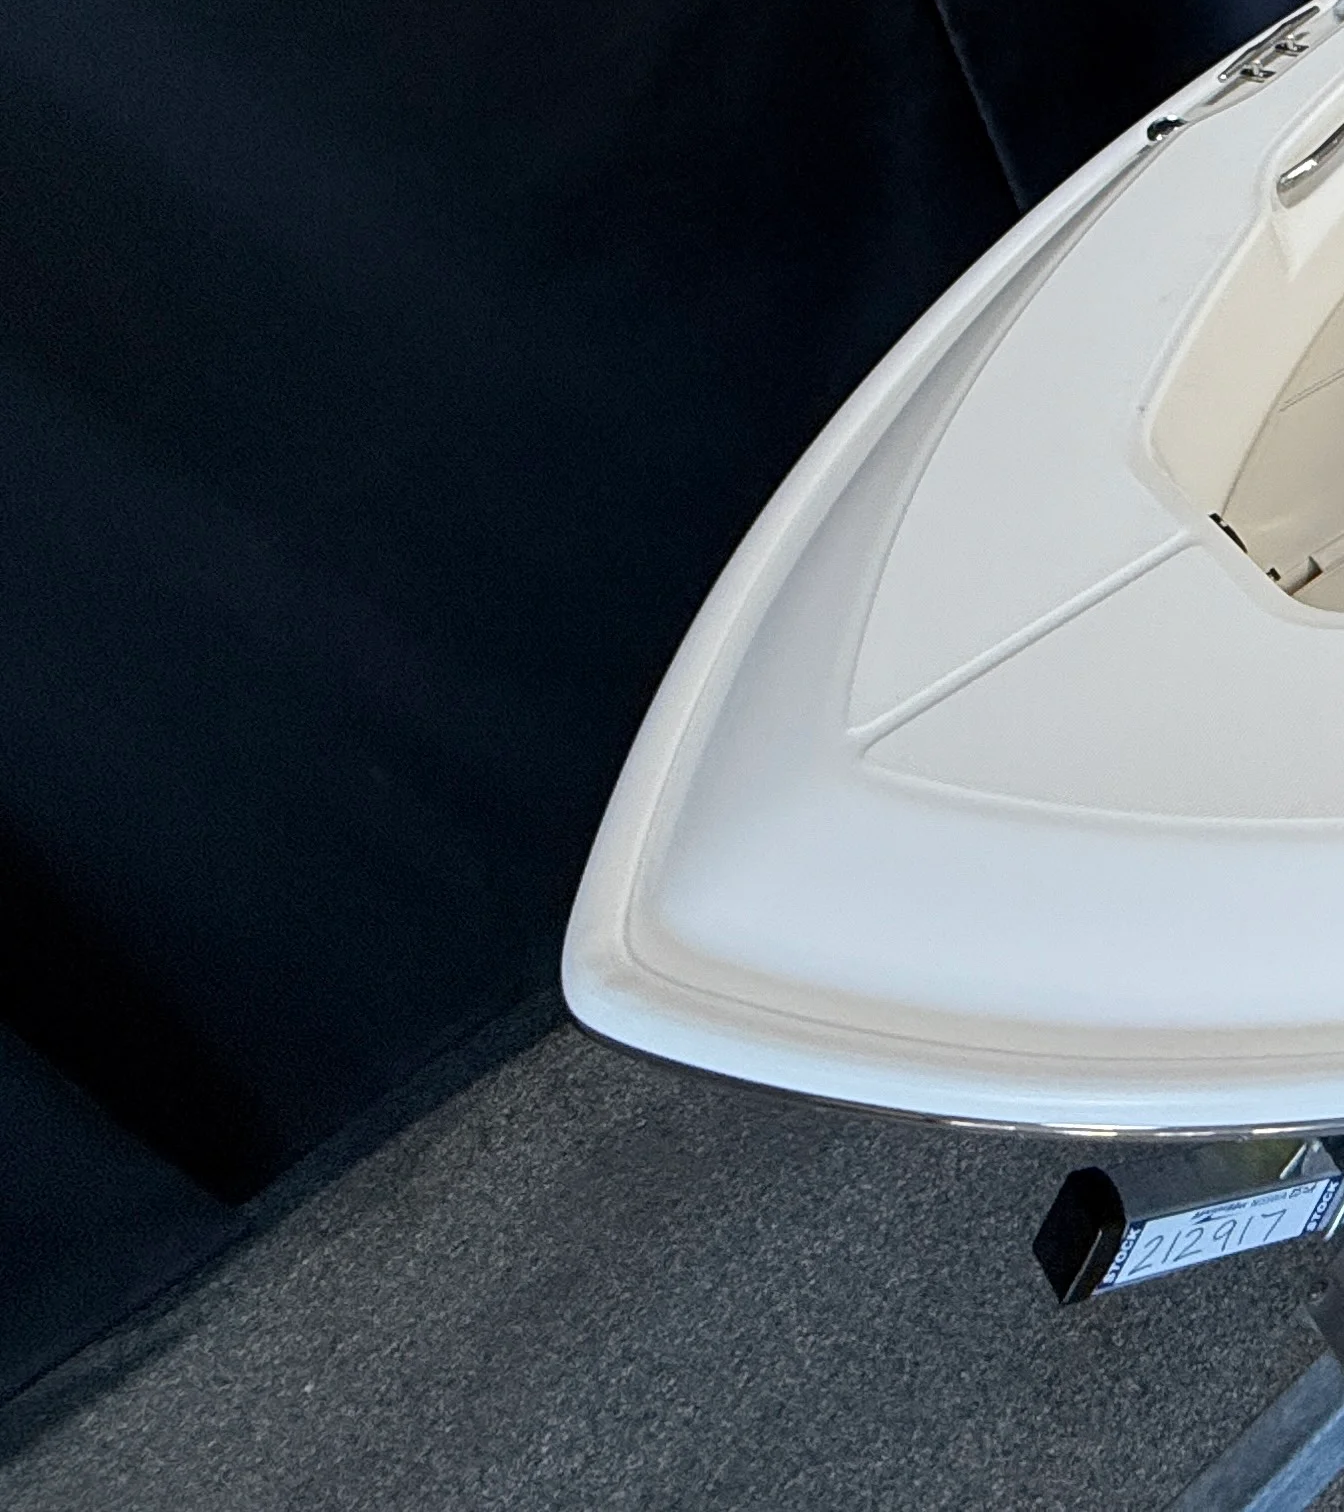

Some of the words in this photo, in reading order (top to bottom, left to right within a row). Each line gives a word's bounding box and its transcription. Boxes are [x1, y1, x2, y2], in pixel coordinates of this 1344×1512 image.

[1306, 1181, 1340, 1232] STOCK
[1102, 1227, 1141, 1285] STOCK
[1127, 1208, 1287, 1276] 212917
